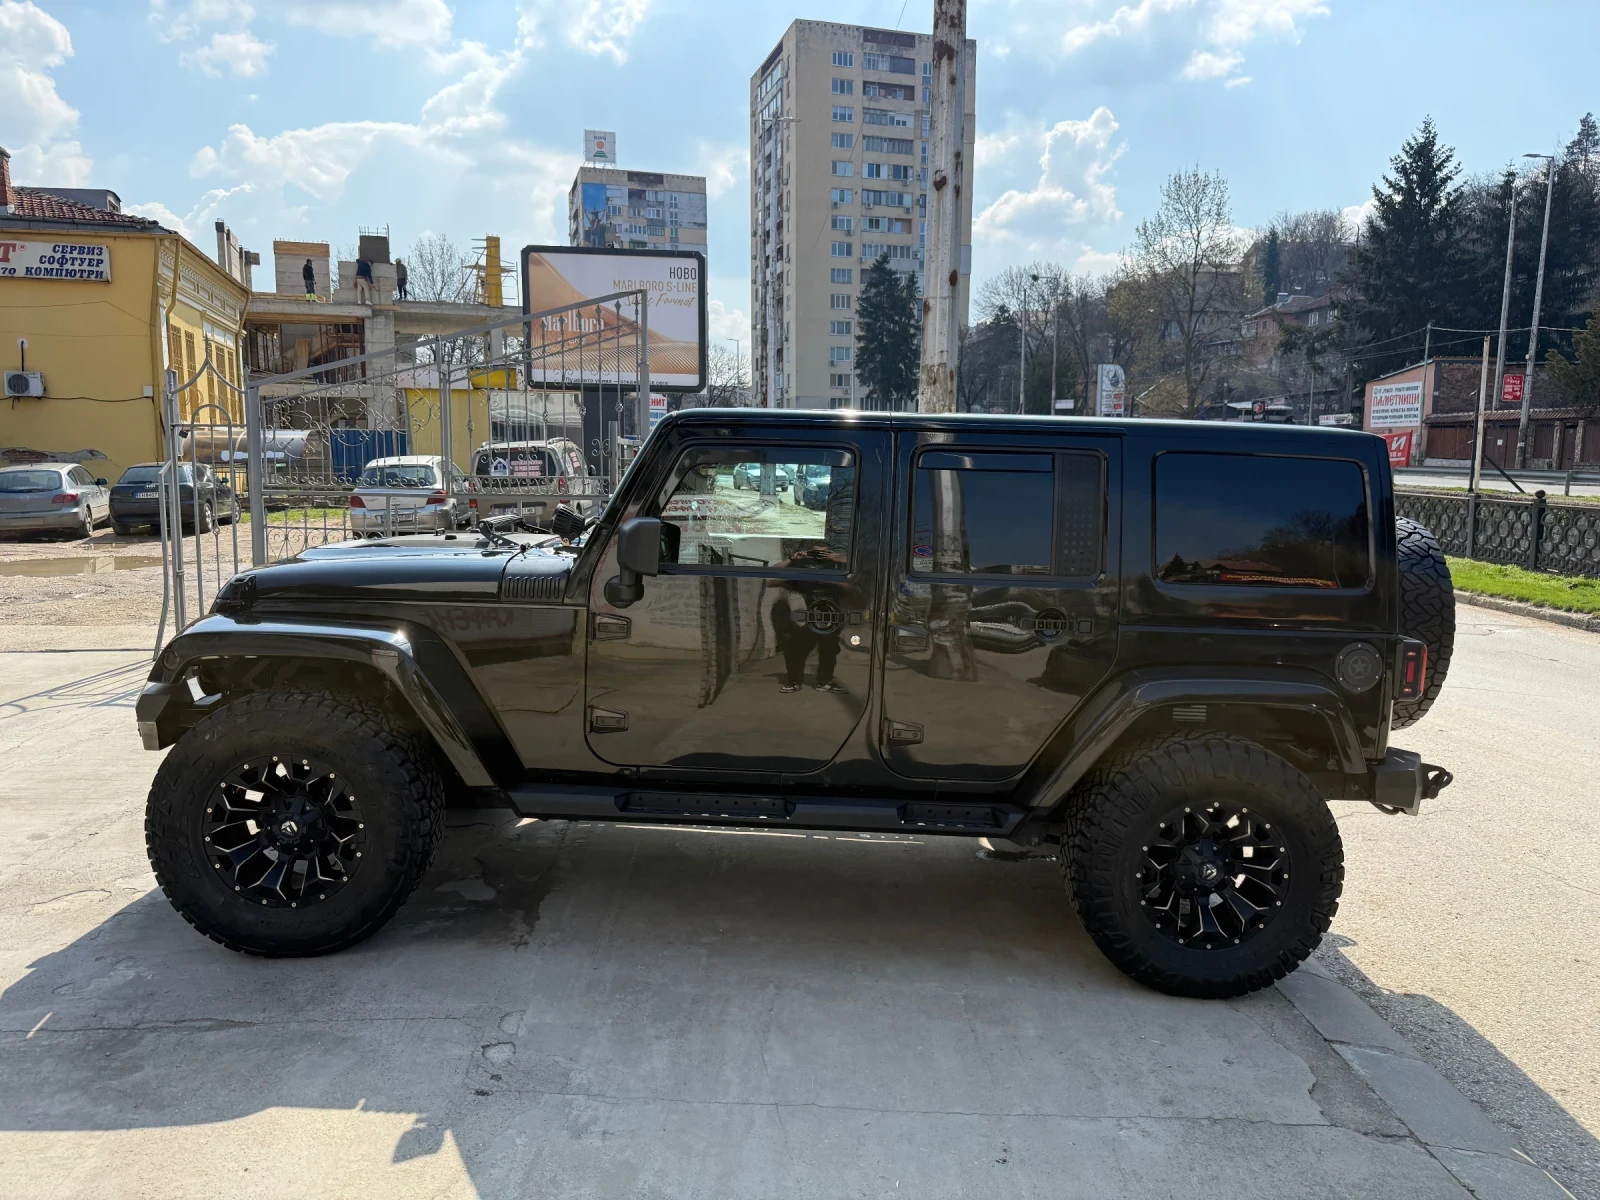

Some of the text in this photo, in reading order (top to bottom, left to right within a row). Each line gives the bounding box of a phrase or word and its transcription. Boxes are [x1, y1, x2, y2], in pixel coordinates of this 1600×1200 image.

[52, 244, 104, 256] СЕРВИЗ
[38, 255, 104, 268] СОФТУЕР
[24, 266, 105, 280] КОМПЮТРИ
[655, 292, 695, 309] Format
